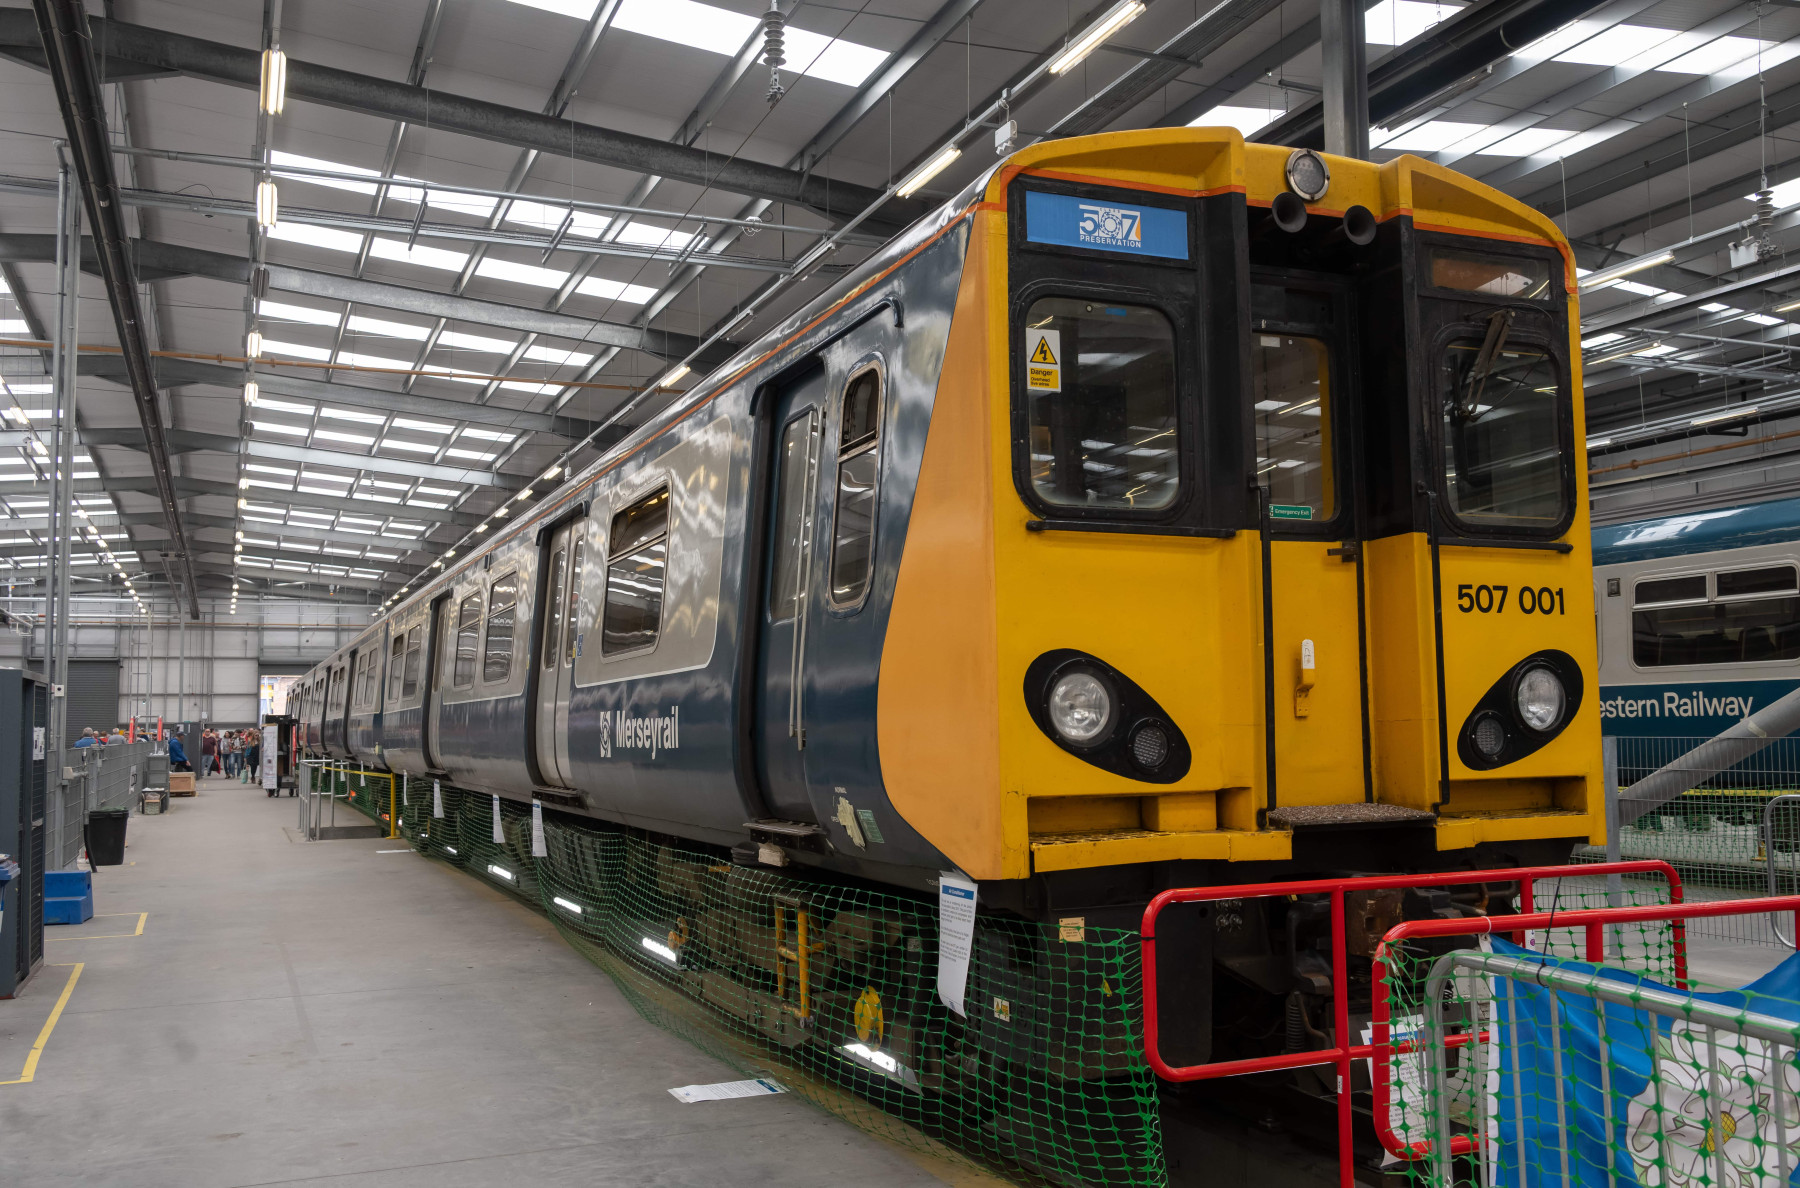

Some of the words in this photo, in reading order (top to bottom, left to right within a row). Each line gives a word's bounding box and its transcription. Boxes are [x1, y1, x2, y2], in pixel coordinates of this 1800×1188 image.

[1079, 206, 1139, 241] 507
[1080, 234, 1141, 248] PRESERVATION
[1030, 368, 1053, 376] Danger
[1458, 584, 1508, 613] 507
[1519, 586, 1564, 615] 001
[1600, 696, 1659, 718] estern
[1664, 691, 1753, 722] Railway
[616, 706, 678, 760] Merseyrail
